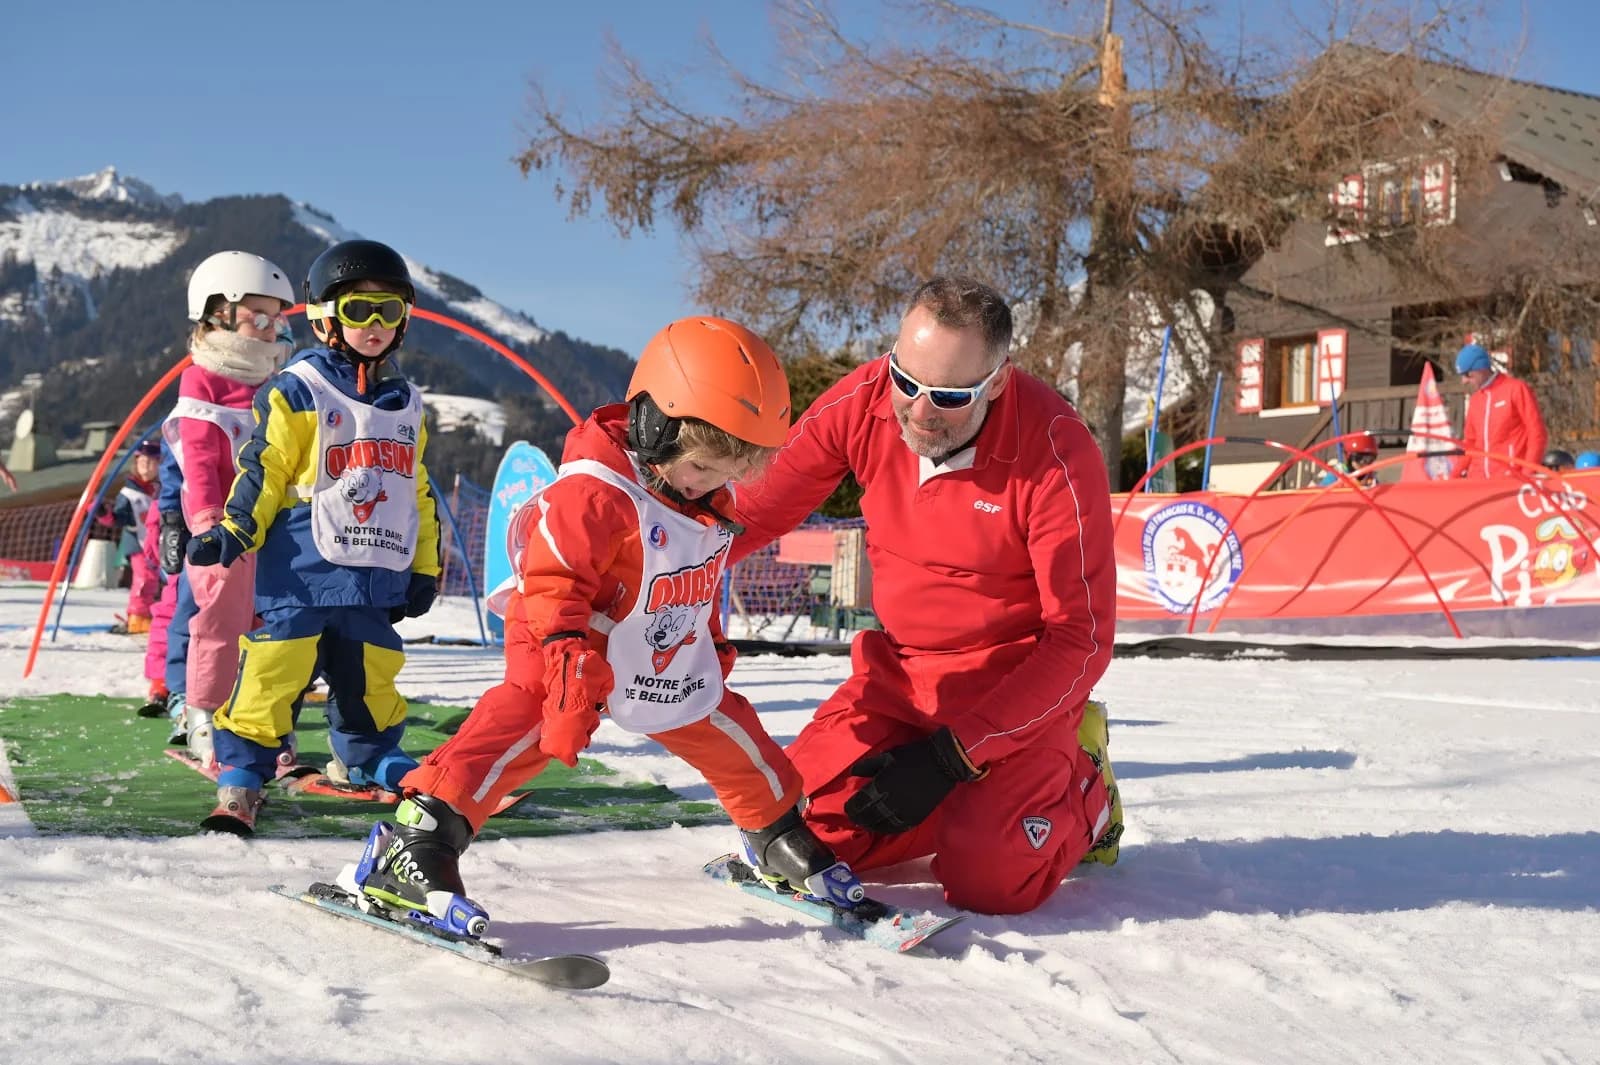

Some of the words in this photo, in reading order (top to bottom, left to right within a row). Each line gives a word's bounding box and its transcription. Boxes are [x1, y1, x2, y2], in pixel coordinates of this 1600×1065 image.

[326, 438, 415, 480] OURSON
[344, 526, 383, 537] NOTRE
[334, 536, 349, 545] DE
[352, 537, 410, 555] BELLECOMBE
[633, 674, 680, 690] NOTRE
[625, 687, 636, 700] DE
